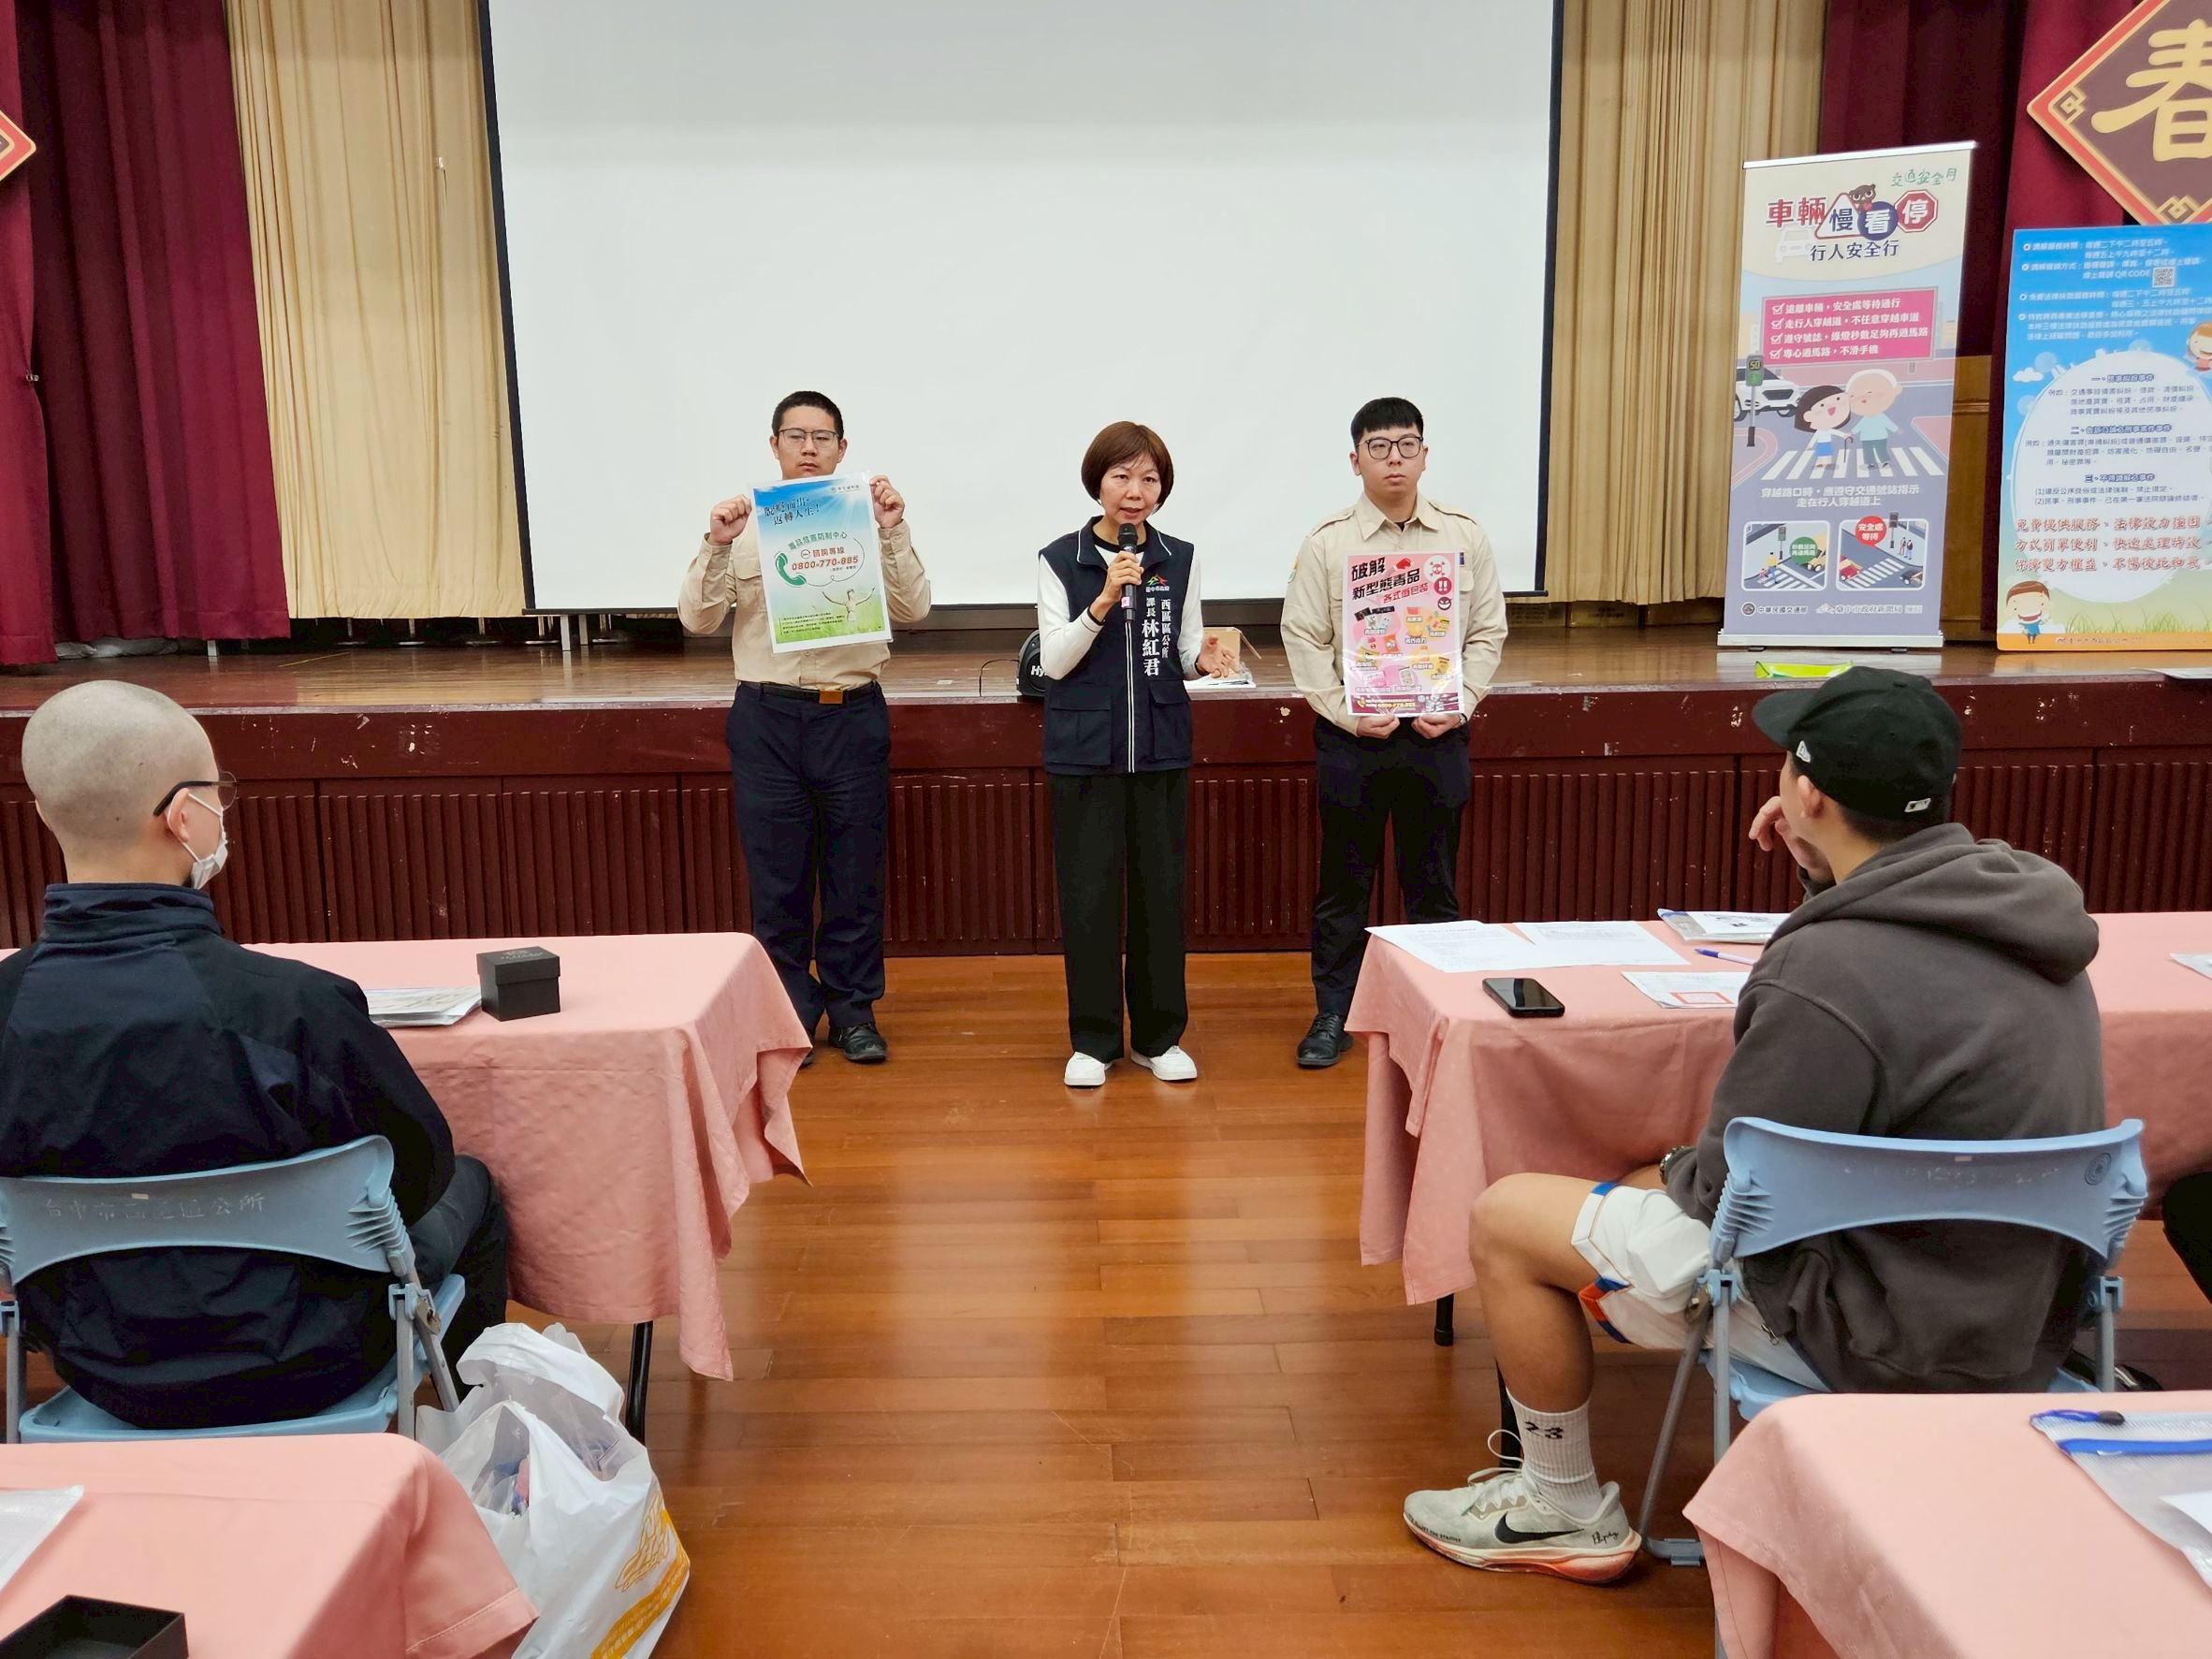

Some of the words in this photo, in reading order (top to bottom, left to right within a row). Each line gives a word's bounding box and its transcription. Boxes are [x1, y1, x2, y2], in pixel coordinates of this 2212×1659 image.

[1891, 167, 1957, 186] 交通安全月
[1811, 240, 1899, 262] 行人安全行
[1797, 496, 1882, 508] 走在行人穿越道上
[1862, 532, 1880, 541] 等待
[792, 556, 859, 571] 0800-770-885
[1351, 556, 1386, 582] 破解
[1352, 568, 1420, 600] 新型態毒品
[1161, 599, 1171, 659] 西區區公所
[1141, 618, 1161, 677] 林紅君
[1030, 665, 1047, 677] Hy
